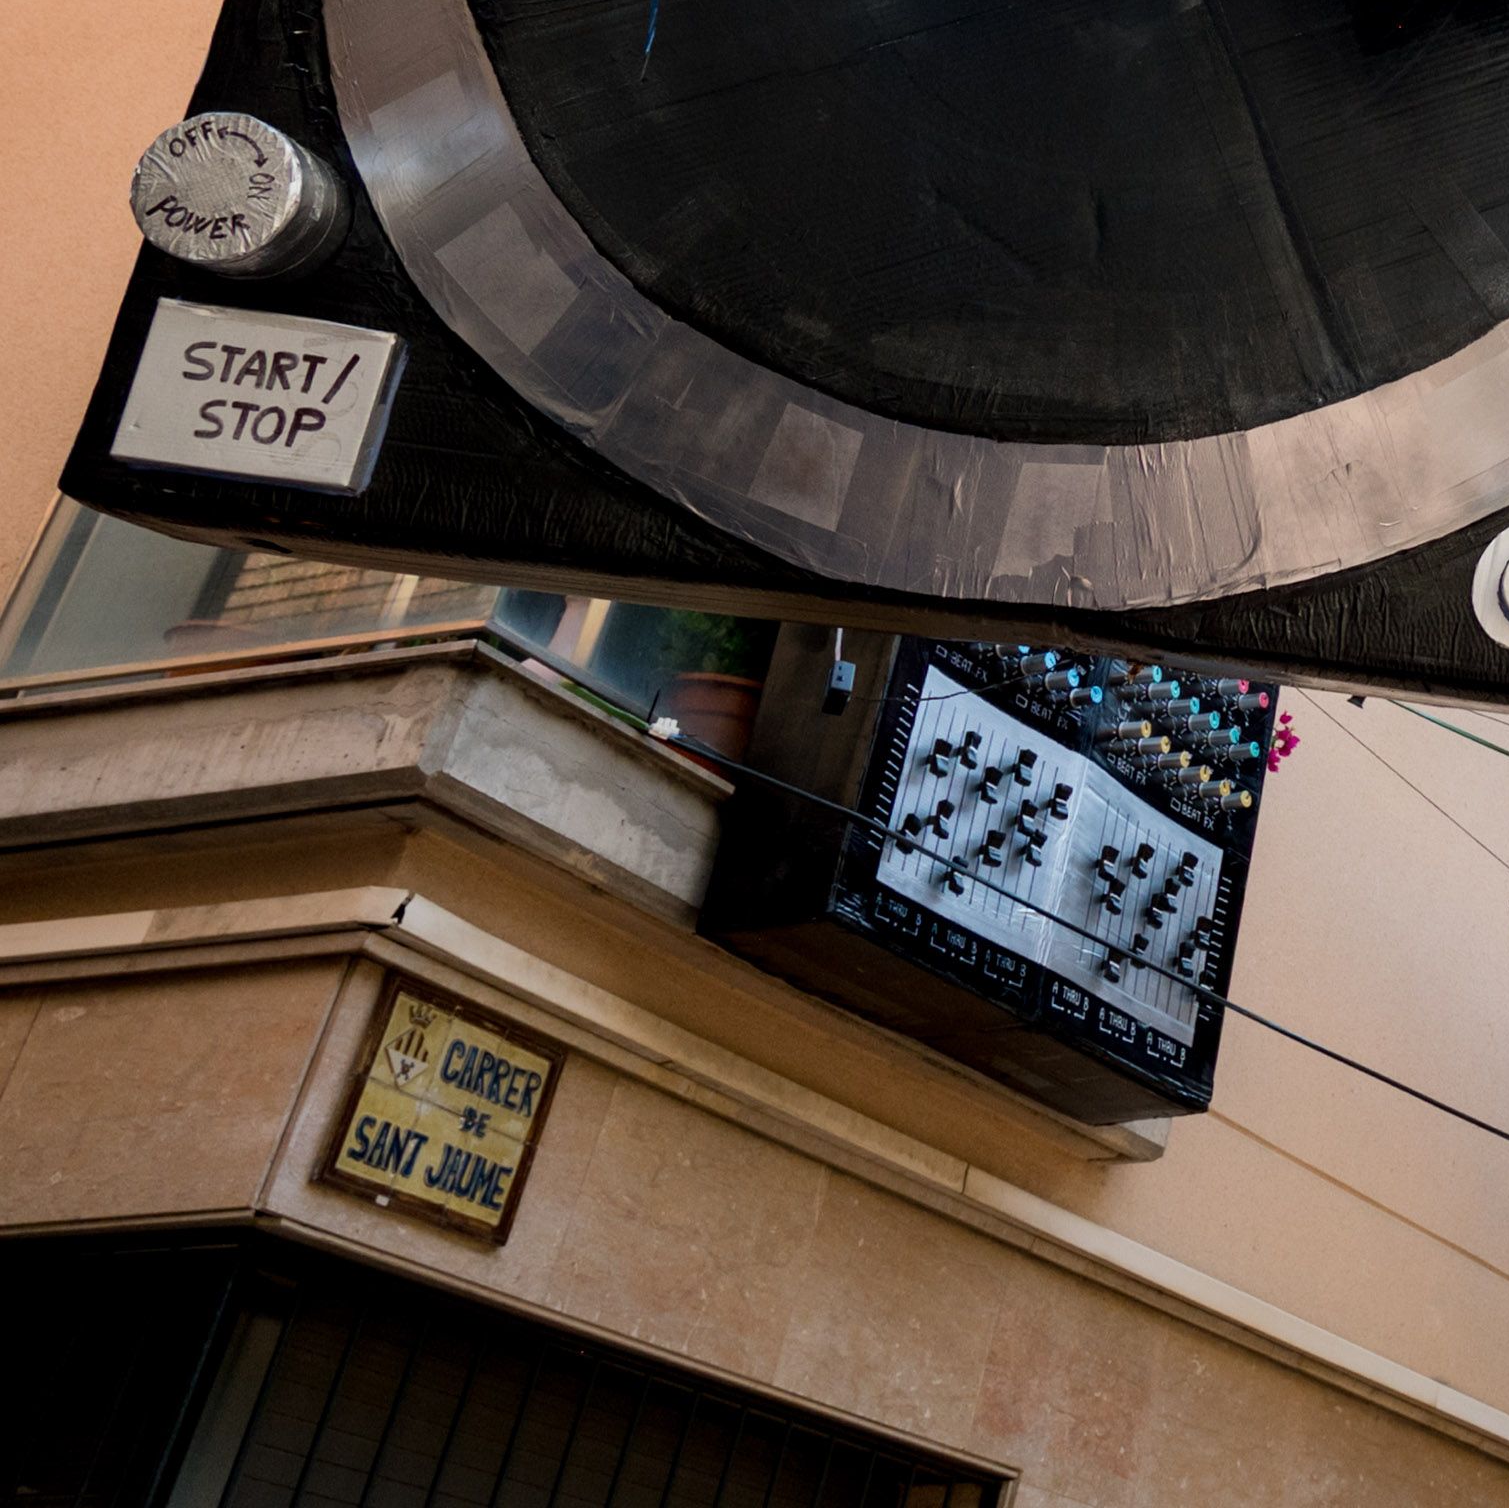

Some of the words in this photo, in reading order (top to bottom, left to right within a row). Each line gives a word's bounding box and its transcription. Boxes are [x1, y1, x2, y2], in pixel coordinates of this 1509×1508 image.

[169, 121, 215, 159] OFF
[248, 171, 275, 200] ON
[146, 195, 250, 240] POWER
[183, 342, 360, 403] START/
[193, 400, 327, 448] STOP
[950, 650, 976, 674] BEAT
[1030, 700, 1054, 721] BEAT
[1056, 713, 1070, 731] FX
[1116, 758, 1139, 782] BEAT
[1135, 770, 1149, 787] FX
[1181, 799, 1203, 822] BEAT
[1203, 814, 1217, 832] FX
[1052, 980, 1059, 996] A
[1062, 985, 1081, 1007] THRU
[1099, 1006, 1105, 1021] A
[1109, 1010, 1128, 1032] THRU
[1146, 1031, 1154, 1045] A
[1157, 1036, 1177, 1057] THRU
[440, 1038, 543, 1119] CARRER
[460, 1106, 492, 1138] DE
[347, 1114, 429, 1178] SANT
[424, 1143, 514, 1211] JAUME
